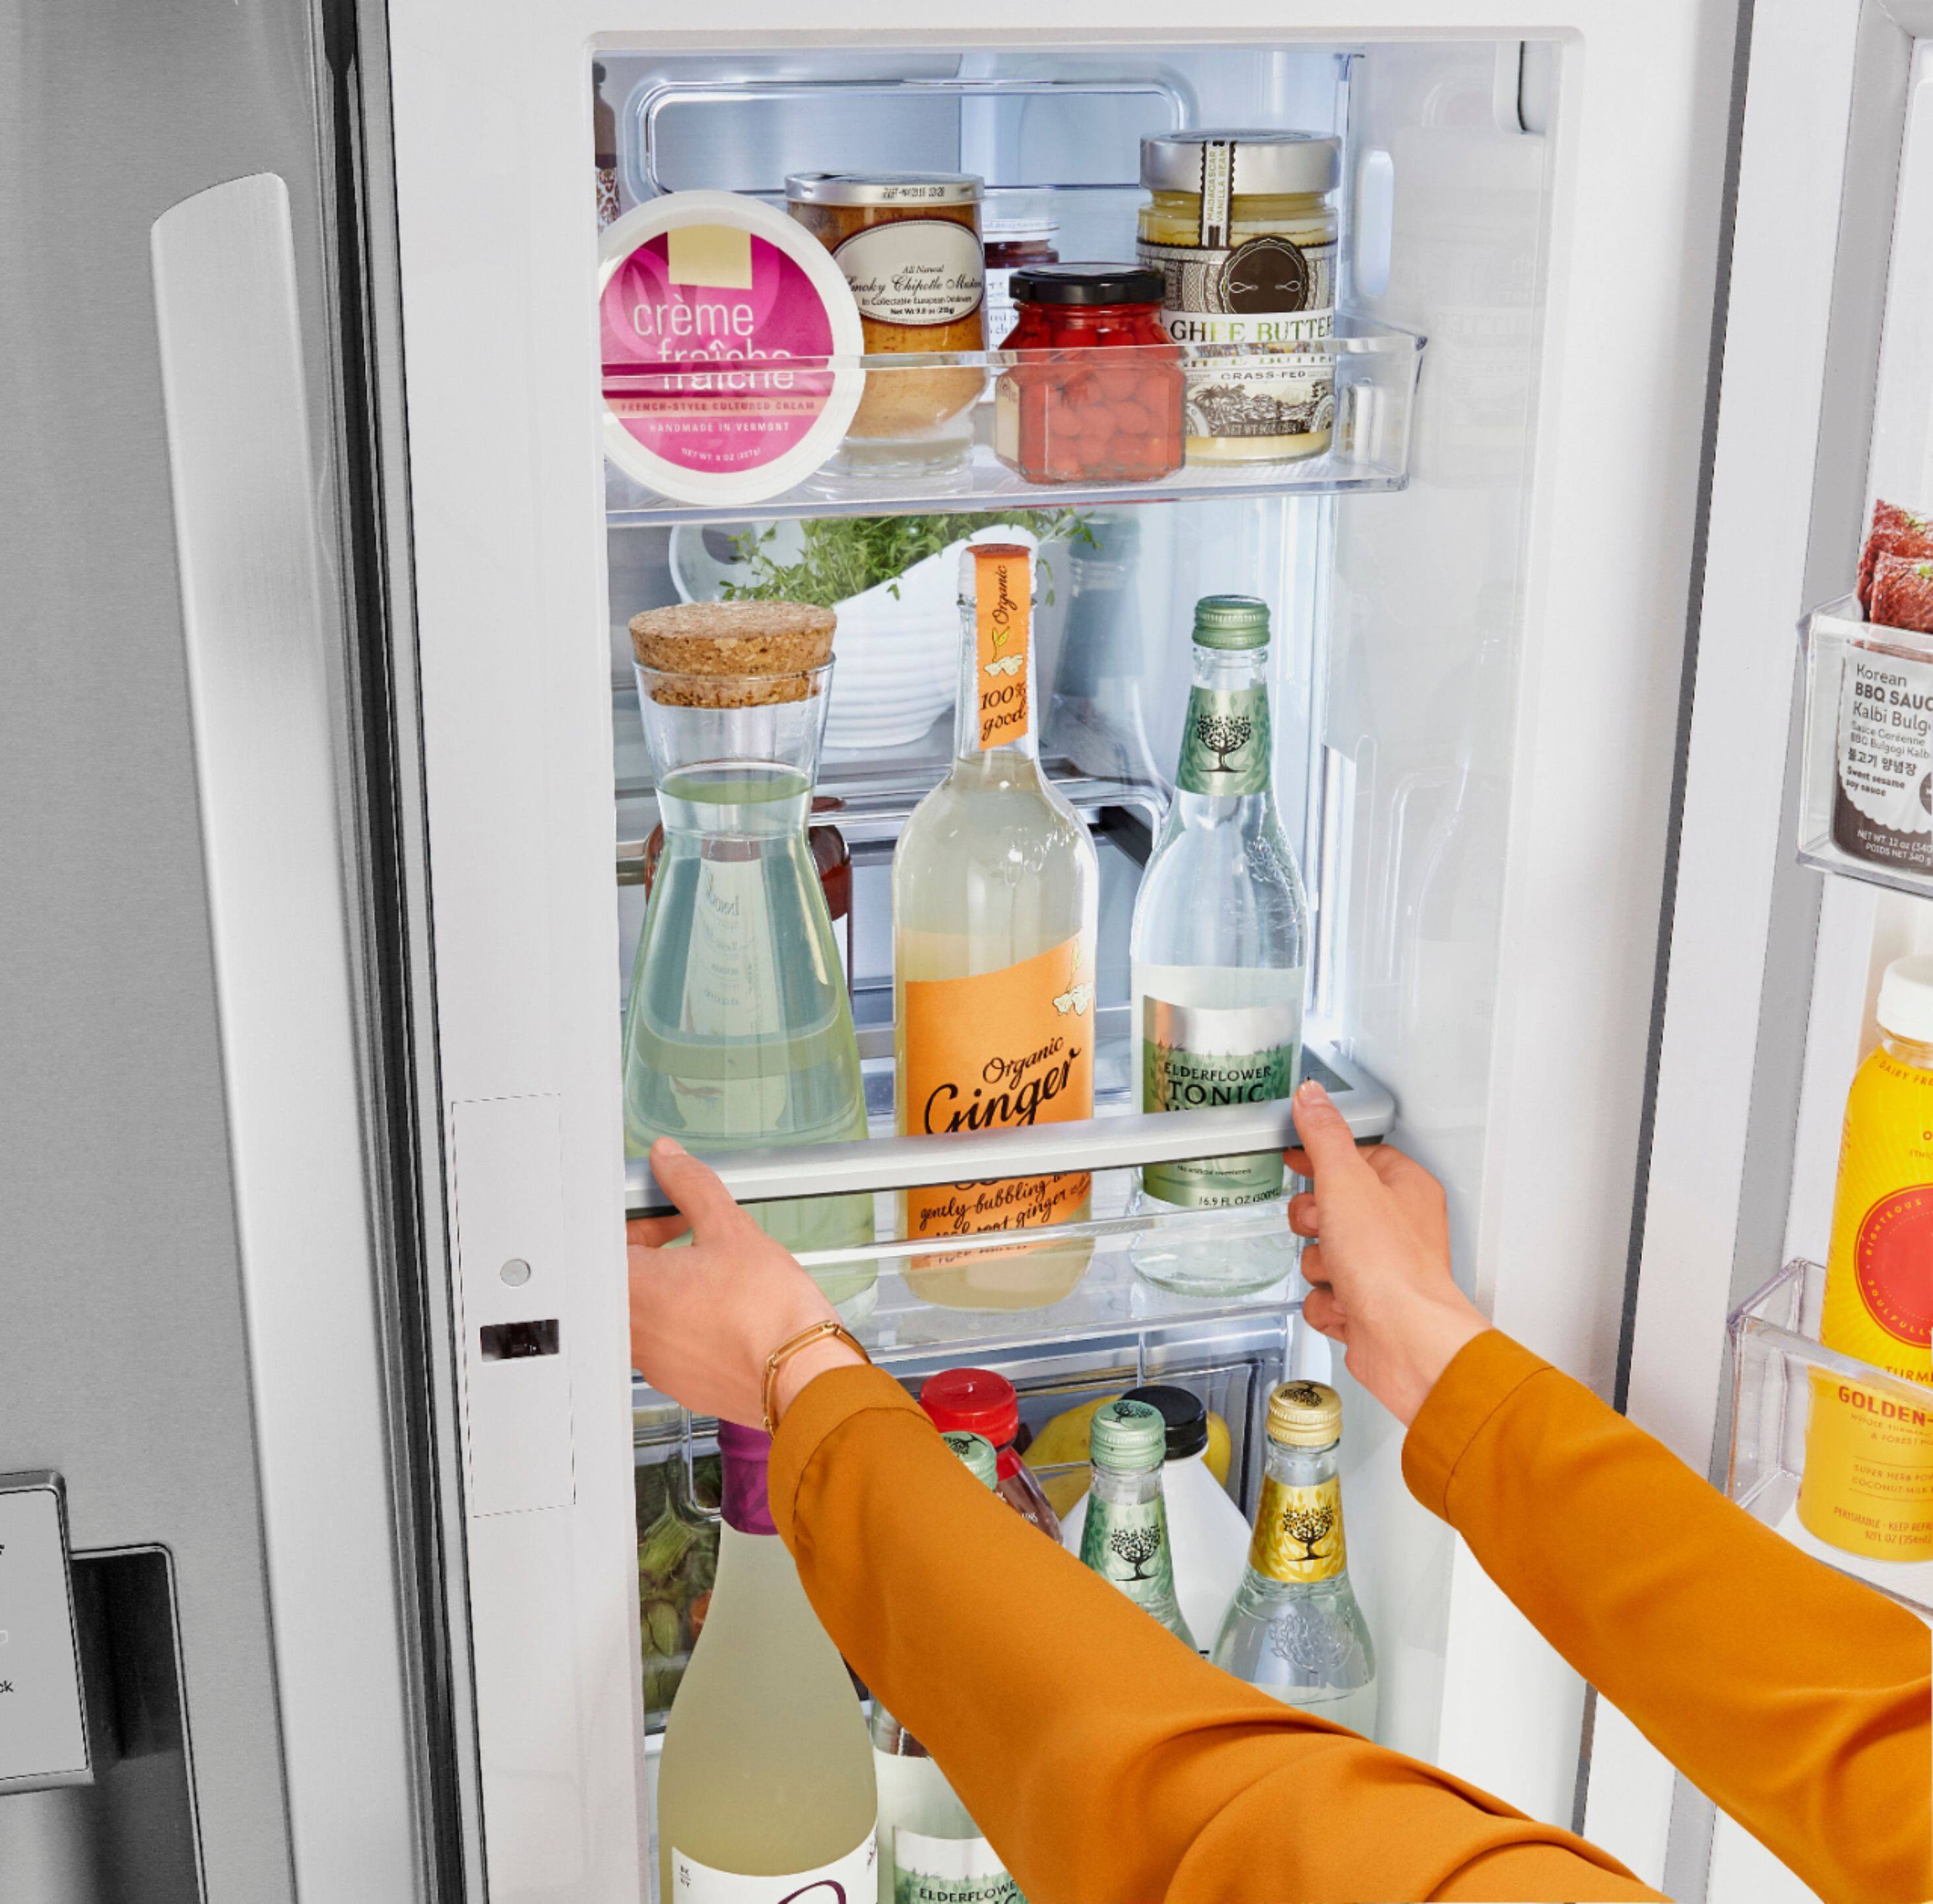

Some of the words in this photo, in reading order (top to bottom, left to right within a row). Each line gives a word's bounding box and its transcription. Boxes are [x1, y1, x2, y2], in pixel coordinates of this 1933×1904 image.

[1218, 150, 1226, 177] BEAN
[1207, 150, 1216, 220] MADAGASCAR
[1216, 180, 1226, 222] VANILLA
[892, 275, 943, 295] Chipotle
[634, 294, 754, 336] crème
[1257, 315, 1333, 342] BUTTER
[1221, 371, 1306, 380] GRASS-FED
[775, 401, 815, 410] CREAM
[649, 422, 713, 432] HANDMADE
[718, 422, 731, 432] IN
[735, 422, 790, 432] VERMONT
[992, 565, 1018, 624] Organic
[1856, 663, 1907, 687] Korean
[1855, 681, 1885, 703] BBQ
[1852, 700, 1887, 724] Kalbi
[1891, 711, 1930, 737] Bulg
[1870, 738, 1905, 757] Bulgogi
[1848, 747, 1878, 768] 불고기
[1882, 757, 1917, 777] 양념장
[1846, 779, 1858, 791] soy
[1861, 783, 1887, 797] sauce
[1847, 766, 1870, 781] Sweet
[1872, 775, 1905, 789] sesame
[983, 1037, 1065, 1091] Organic
[1164, 1062, 1272, 1082] ELDERFLOWER
[1879, 1060, 1909, 1080] DAIRY
[925, 1047, 1082, 1134] Ginger
[1167, 1080, 1265, 1107] TONIC
[975, 1179, 1051, 1214] bubbling
[1235, 1195, 1251, 1205] OZ
[1886, 1366, 1933, 1383] TURM
